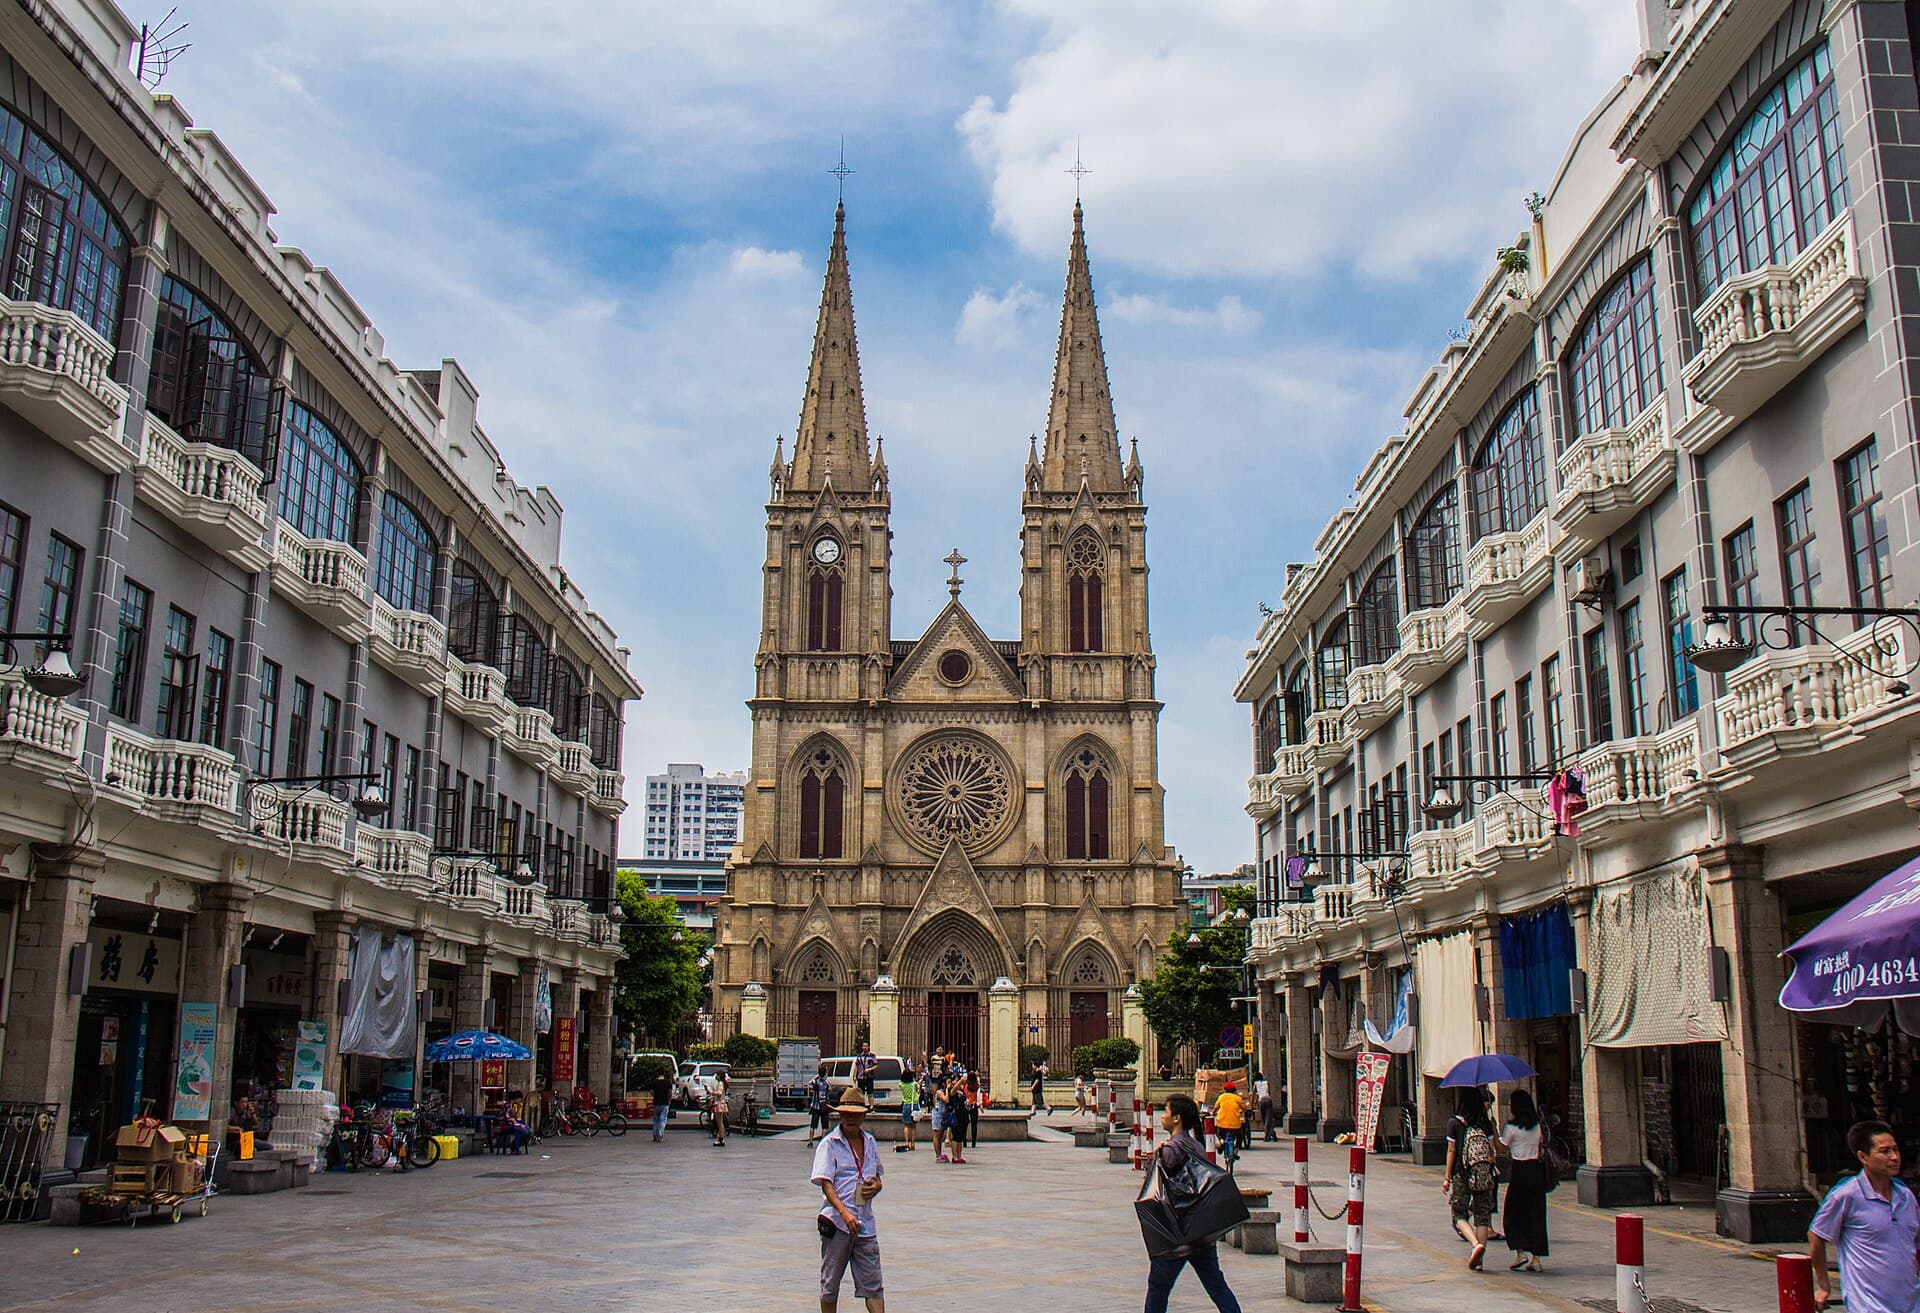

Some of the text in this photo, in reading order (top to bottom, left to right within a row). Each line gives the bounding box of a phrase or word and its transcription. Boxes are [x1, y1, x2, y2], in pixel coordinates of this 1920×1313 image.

[560, 1019, 571, 1052] 粥粉面
[1221, 1049, 1241, 1057] 全路段
